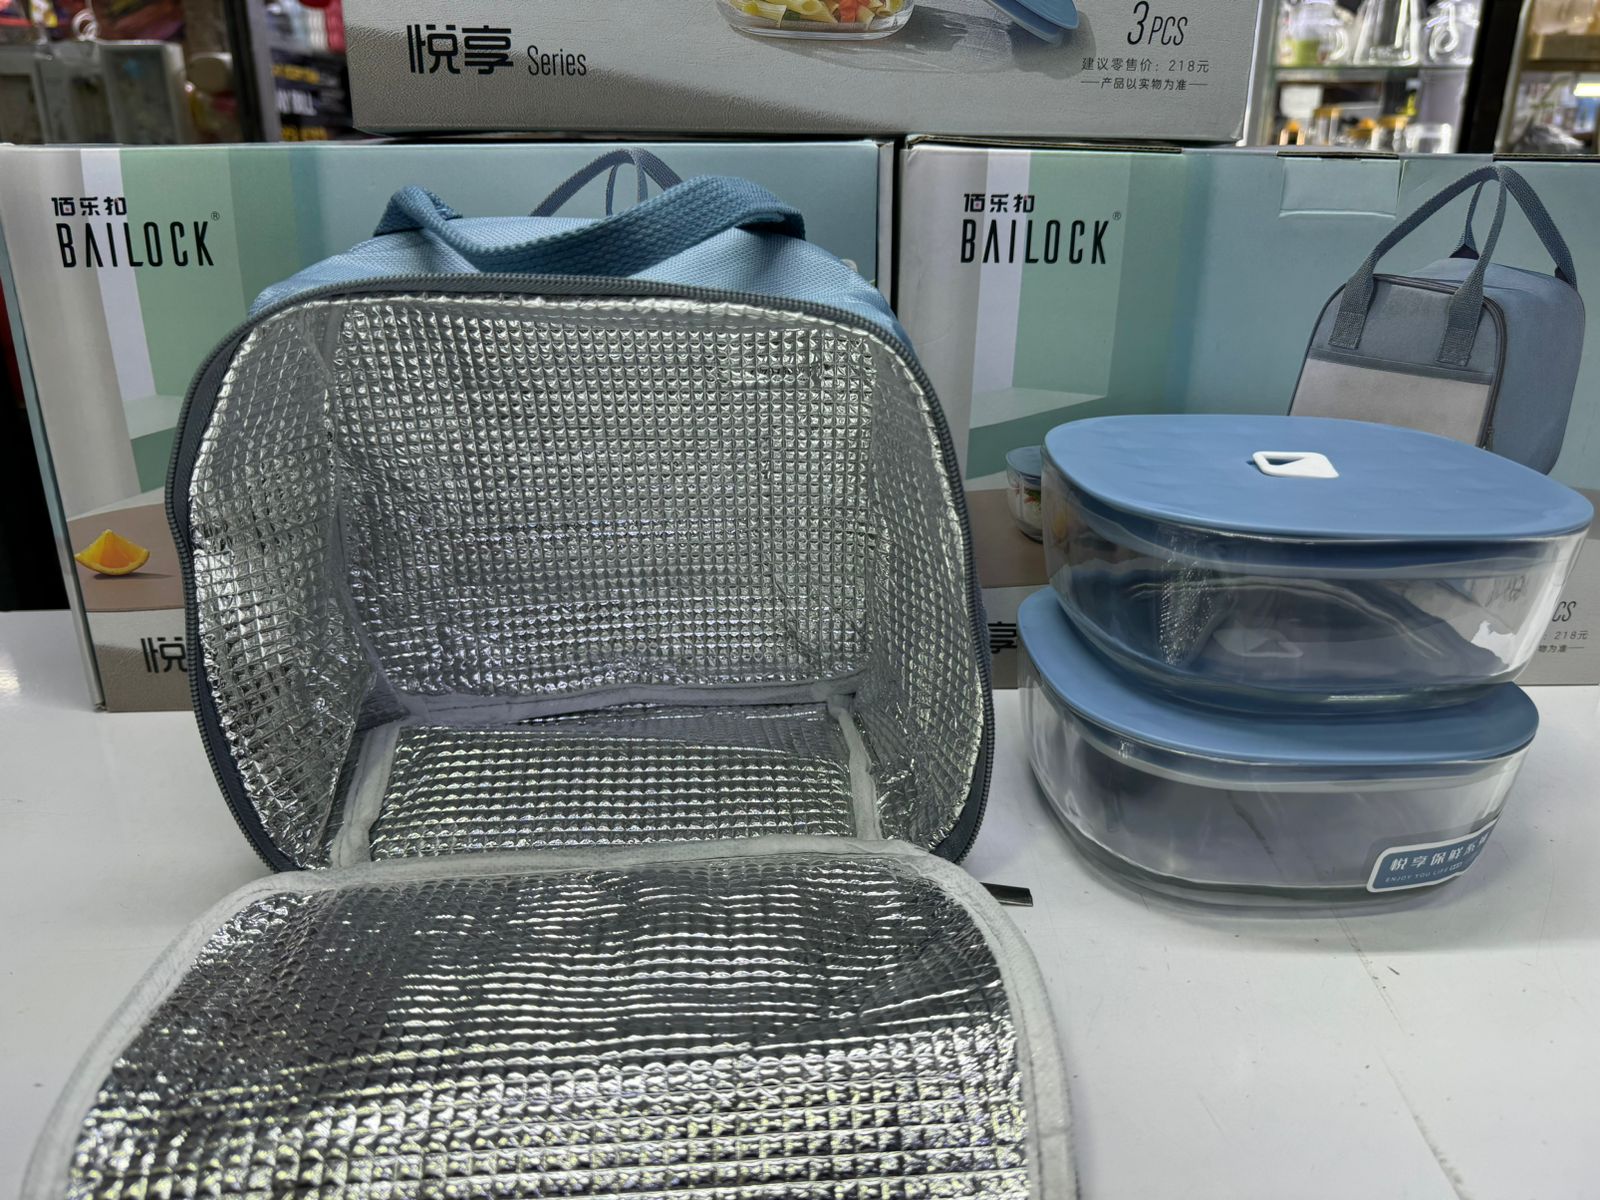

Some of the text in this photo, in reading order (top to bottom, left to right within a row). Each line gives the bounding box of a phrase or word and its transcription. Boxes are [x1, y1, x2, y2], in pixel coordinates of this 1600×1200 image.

[406, 24, 587, 76] 悦享 Series
[1100, 77, 1188, 91] 产品以实物为准
[51, 196, 127, 217] 佰乐扣
[963, 193, 1035, 214] 佰乐扣
